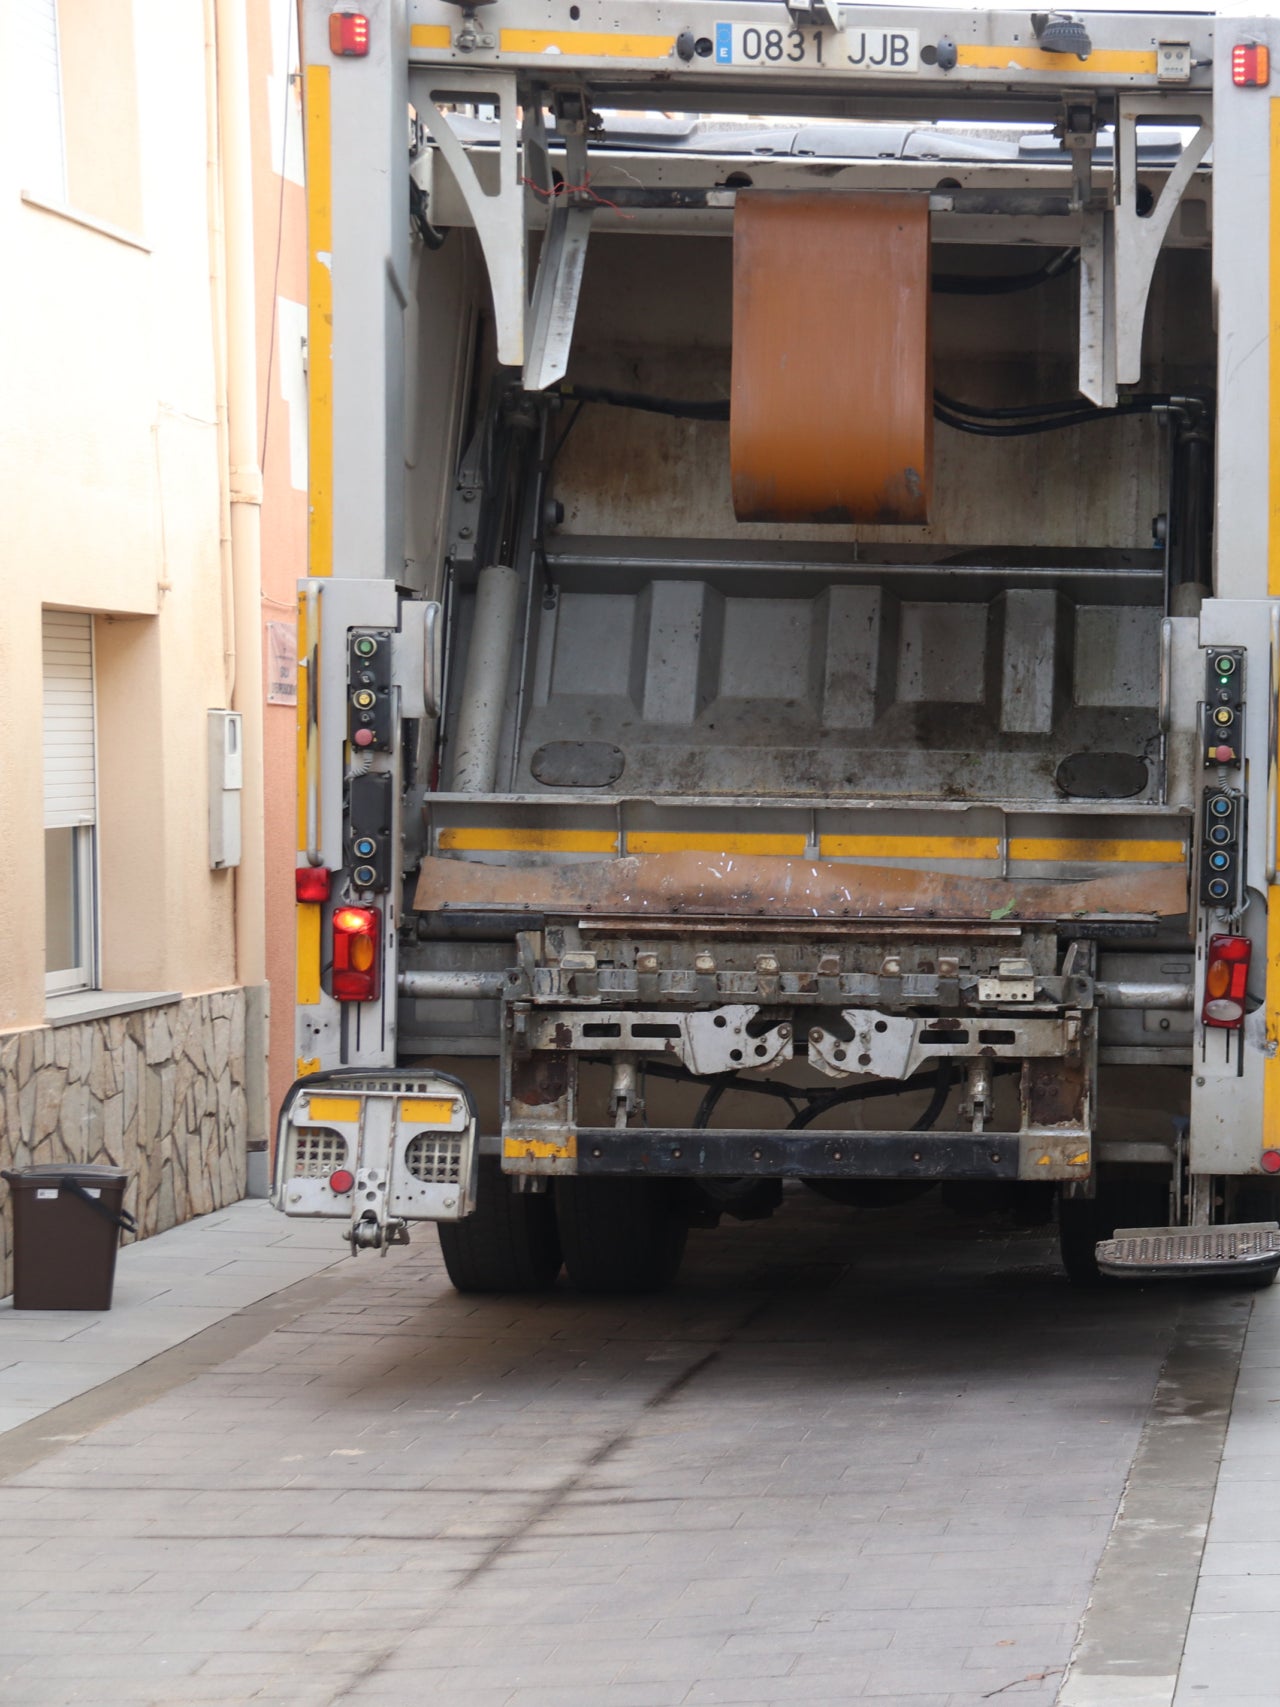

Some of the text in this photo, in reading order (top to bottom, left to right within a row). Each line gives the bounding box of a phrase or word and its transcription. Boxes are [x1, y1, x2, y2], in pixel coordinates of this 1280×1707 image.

[720, 47, 729, 57] E
[743, 28, 909, 66] 0831 JJB
